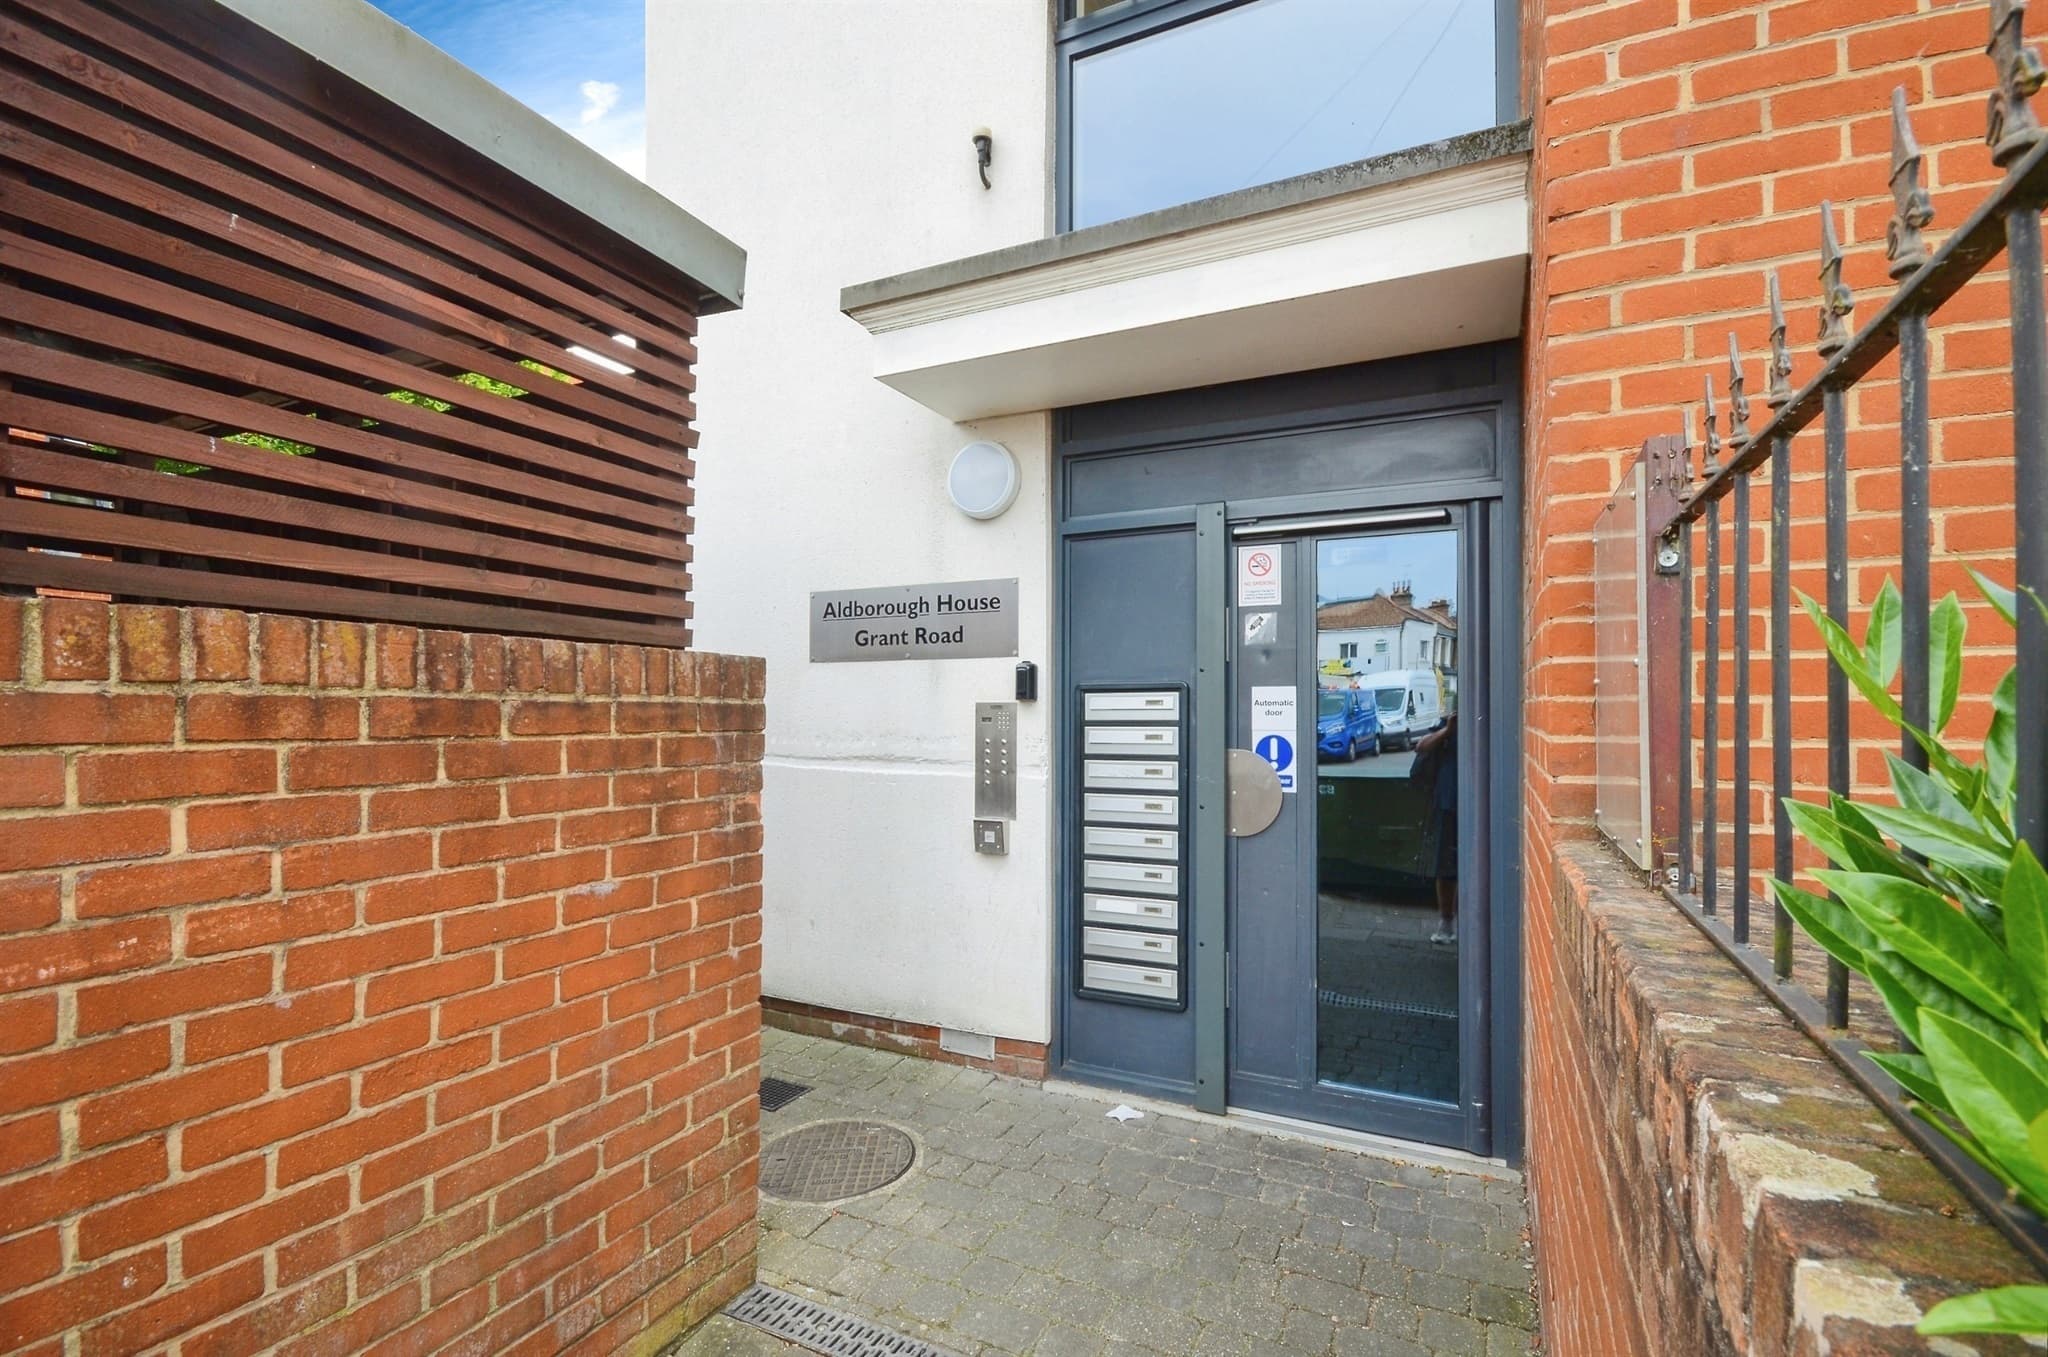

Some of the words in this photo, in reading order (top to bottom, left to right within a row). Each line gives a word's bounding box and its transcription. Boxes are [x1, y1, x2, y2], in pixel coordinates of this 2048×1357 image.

[823, 596, 930, 619] Aldborough
[937, 594, 1001, 612] House
[855, 629, 909, 646] Grant
[915, 625, 964, 644] Road
